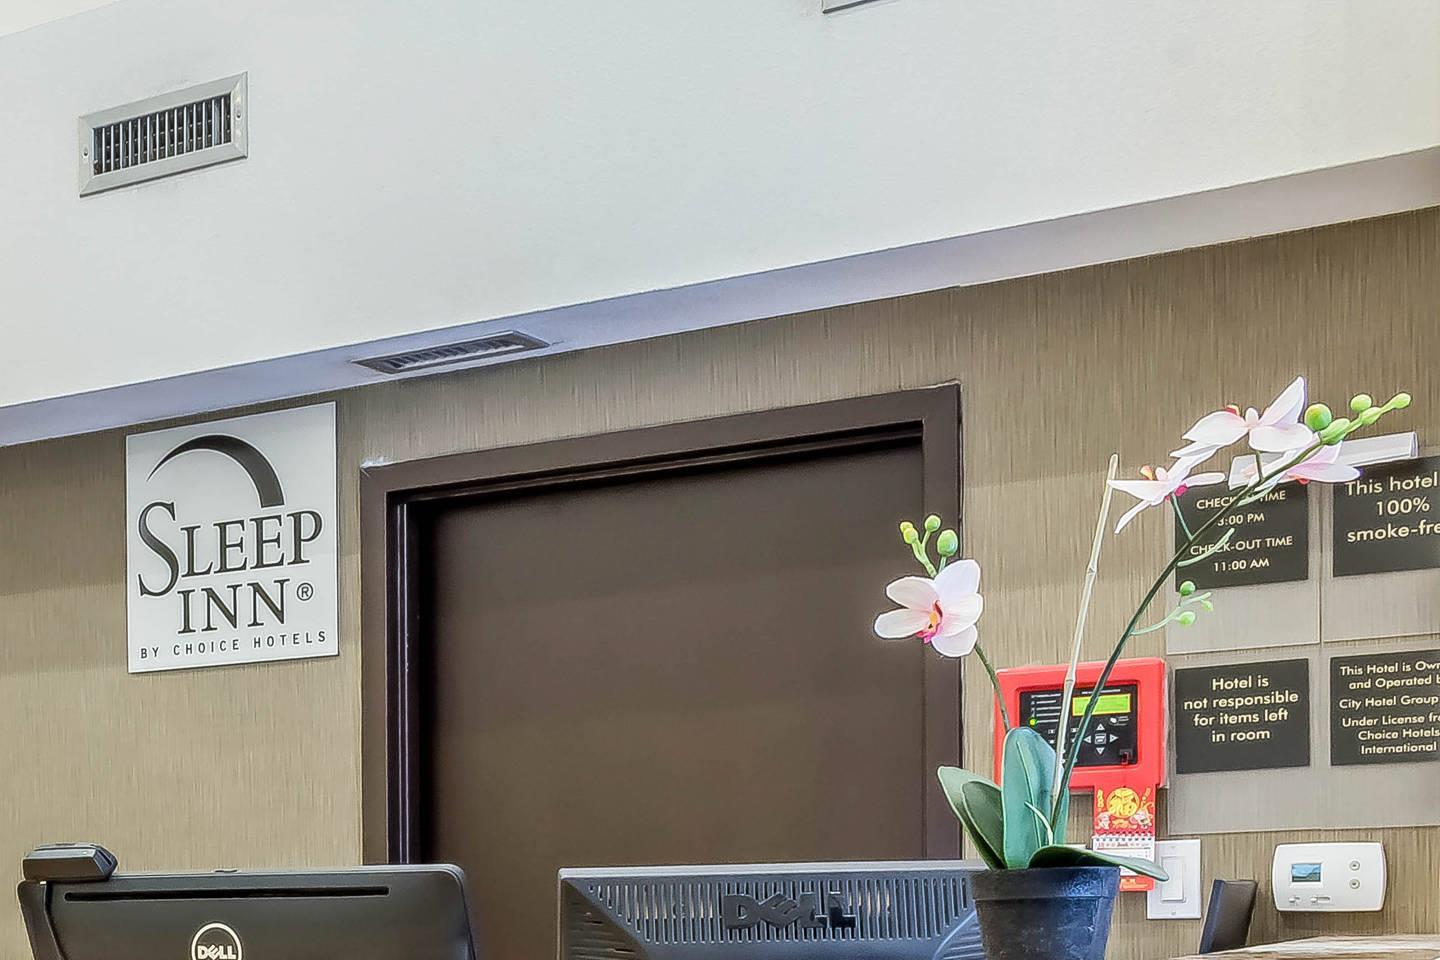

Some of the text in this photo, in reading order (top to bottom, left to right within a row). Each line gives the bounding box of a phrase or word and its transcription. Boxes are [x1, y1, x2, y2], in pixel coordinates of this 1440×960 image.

[1345, 471, 1438, 496] This hotel
[1377, 497, 1430, 516] 100%
[1247, 512, 1265, 523] PM
[137, 500, 323, 597] SLEEP
[1265, 535, 1293, 548] TIME
[1214, 558, 1270, 572] 11:00 AM
[140, 631, 327, 659] BY CHOICE HOTELS
[1340, 665, 1363, 676] This
[1366, 662, 1398, 674] Hotel
[1402, 662, 1412, 672] is
[1212, 675, 1269, 690] Hotel is
[1348, 678, 1371, 690] and
[1375, 674, 1432, 689] Operated
[1184, 690, 1299, 710] not responsible
[1339, 694, 1439, 710] City Hotel Group
[1193, 708, 1288, 726] for items left
[1342, 717, 1378, 727] Under
[1382, 714, 1425, 725] License
[1211, 730, 1271, 742] in room
[1358, 727, 1440, 740] Choice Hotels
[1361, 741, 1437, 754] International
[723, 891, 857, 928] DELL
[197, 944, 237, 960] DELL
